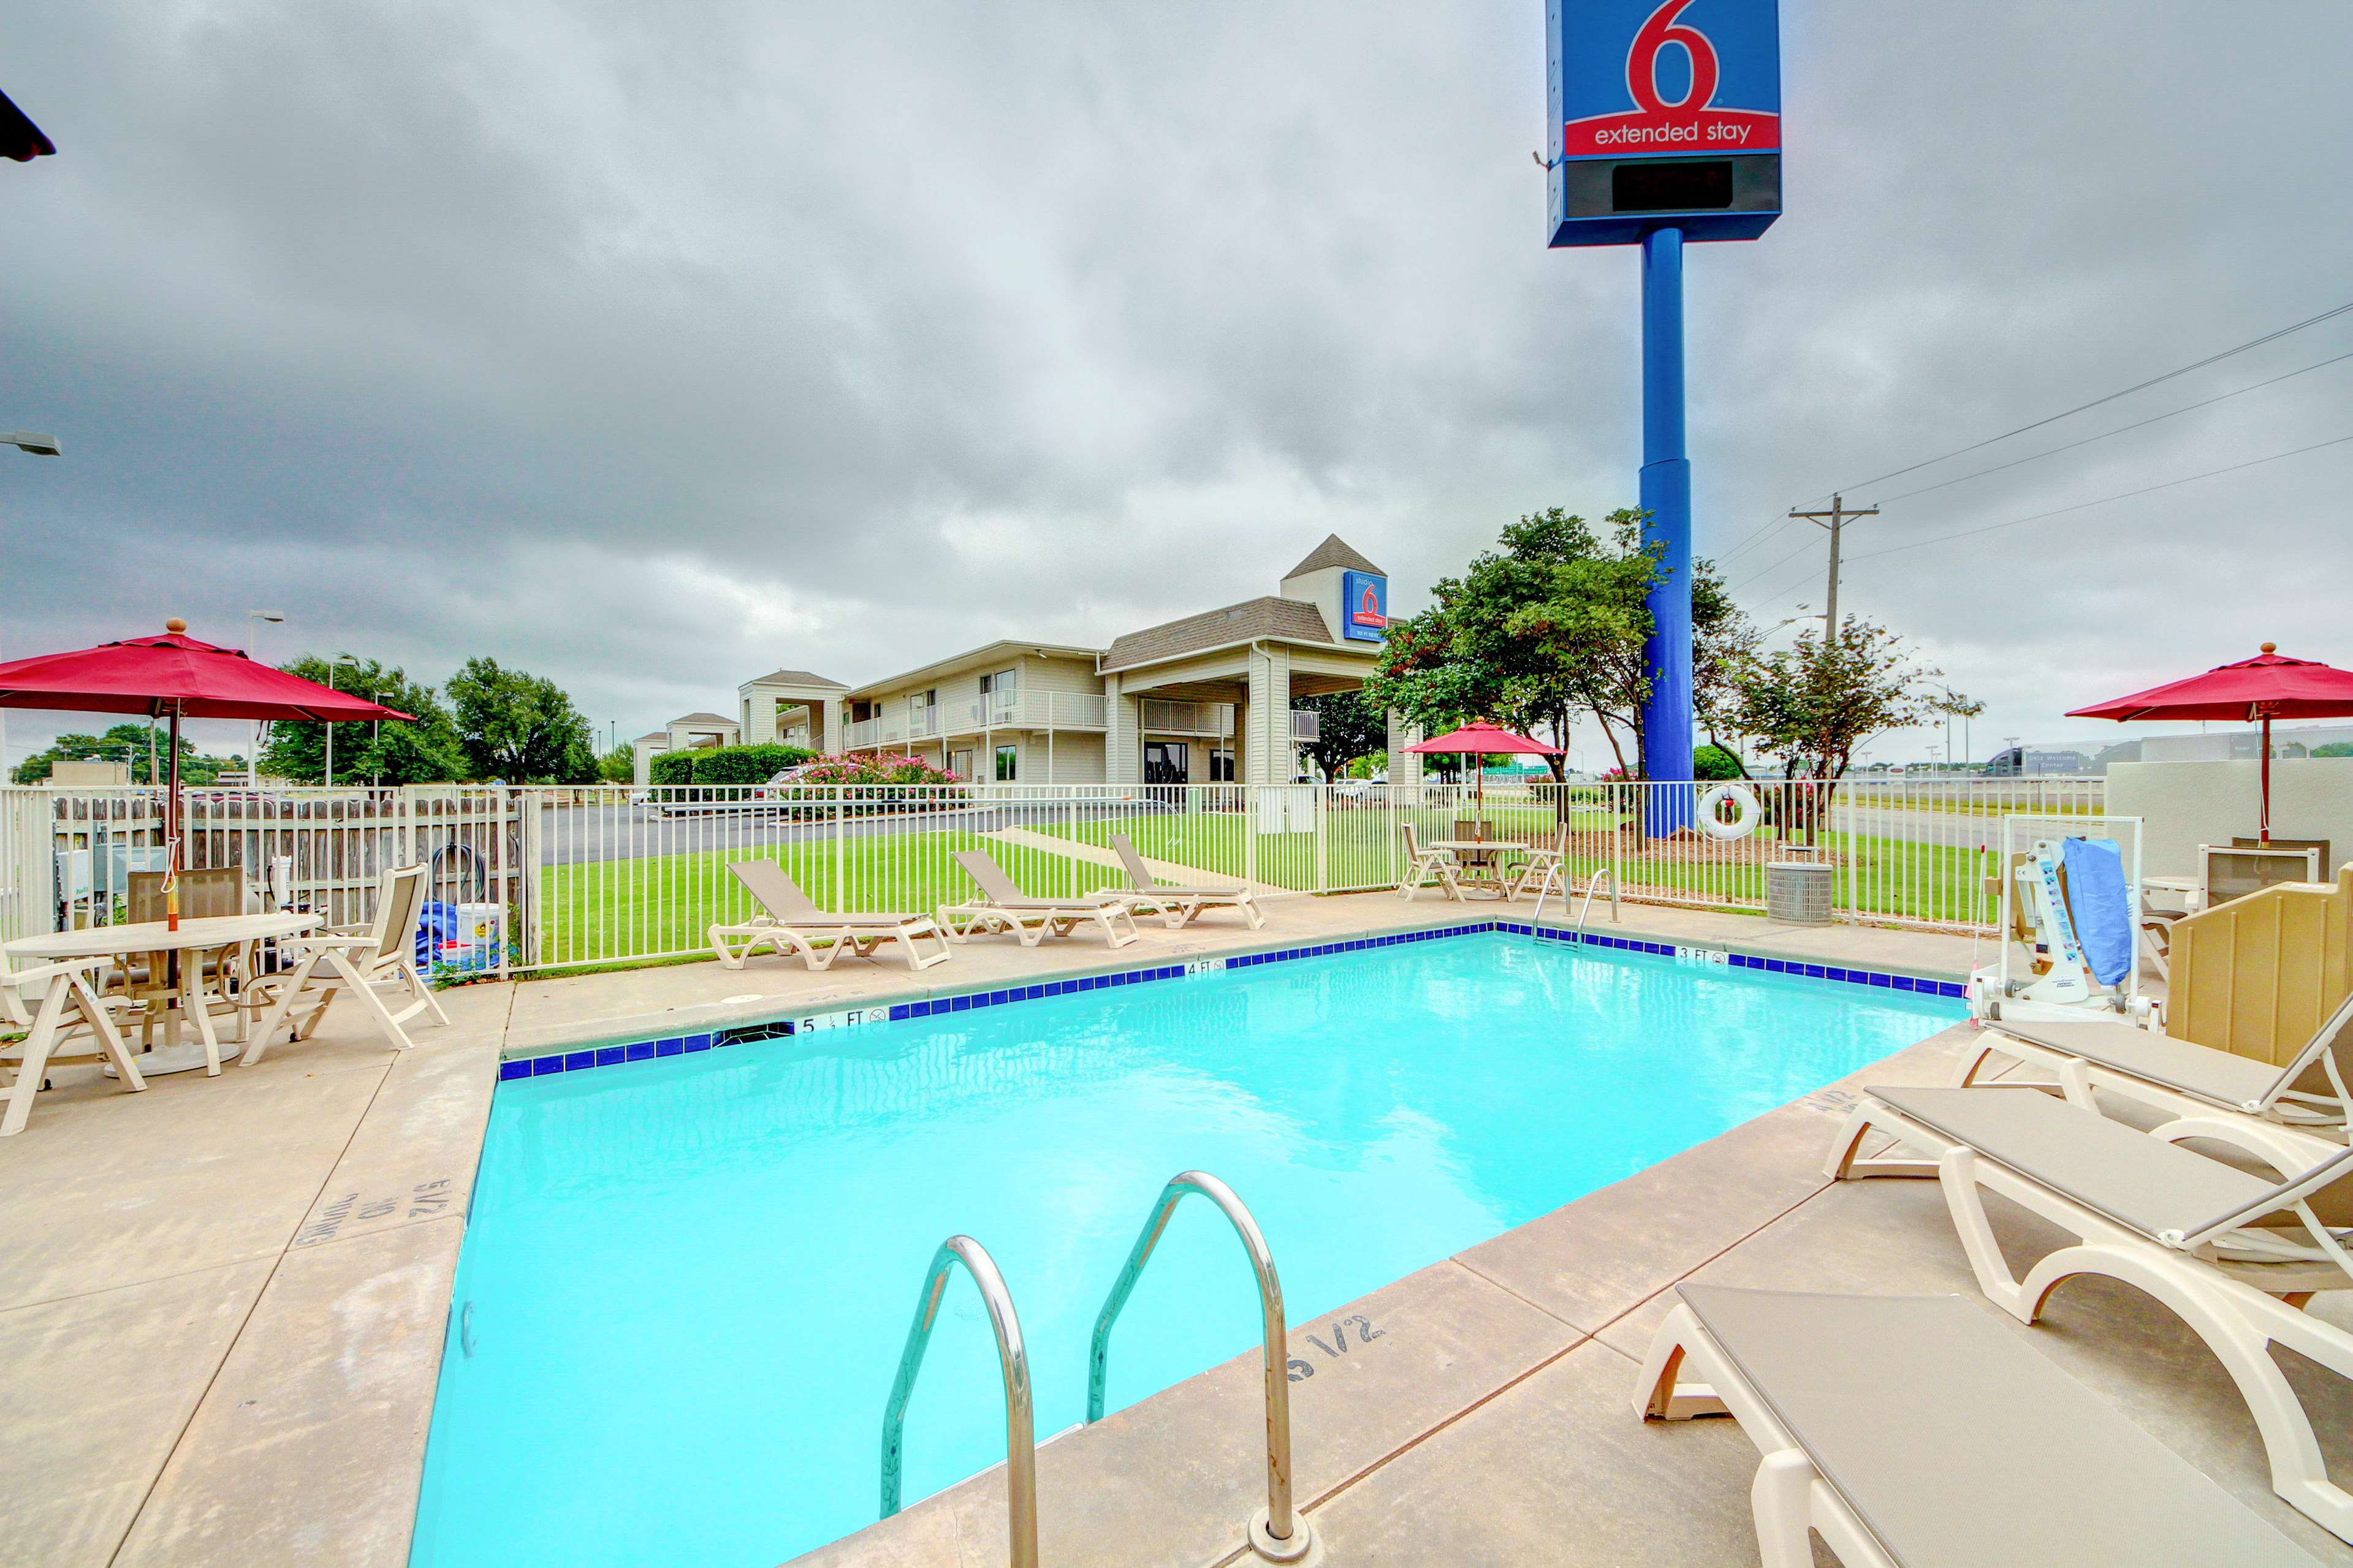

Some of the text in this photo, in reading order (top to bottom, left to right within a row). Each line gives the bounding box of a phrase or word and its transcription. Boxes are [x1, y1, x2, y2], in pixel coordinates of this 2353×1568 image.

[1625, 0, 1720, 112] 6
[1595, 121, 1751, 145] extended stay
[1363, 584, 1378, 614] 6
[1681, 947, 1708, 961] 3 FT
[1188, 961, 1211, 974] 4 FT
[803, 1018, 814, 1034] 5
[847, 1011, 864, 1026] FT
